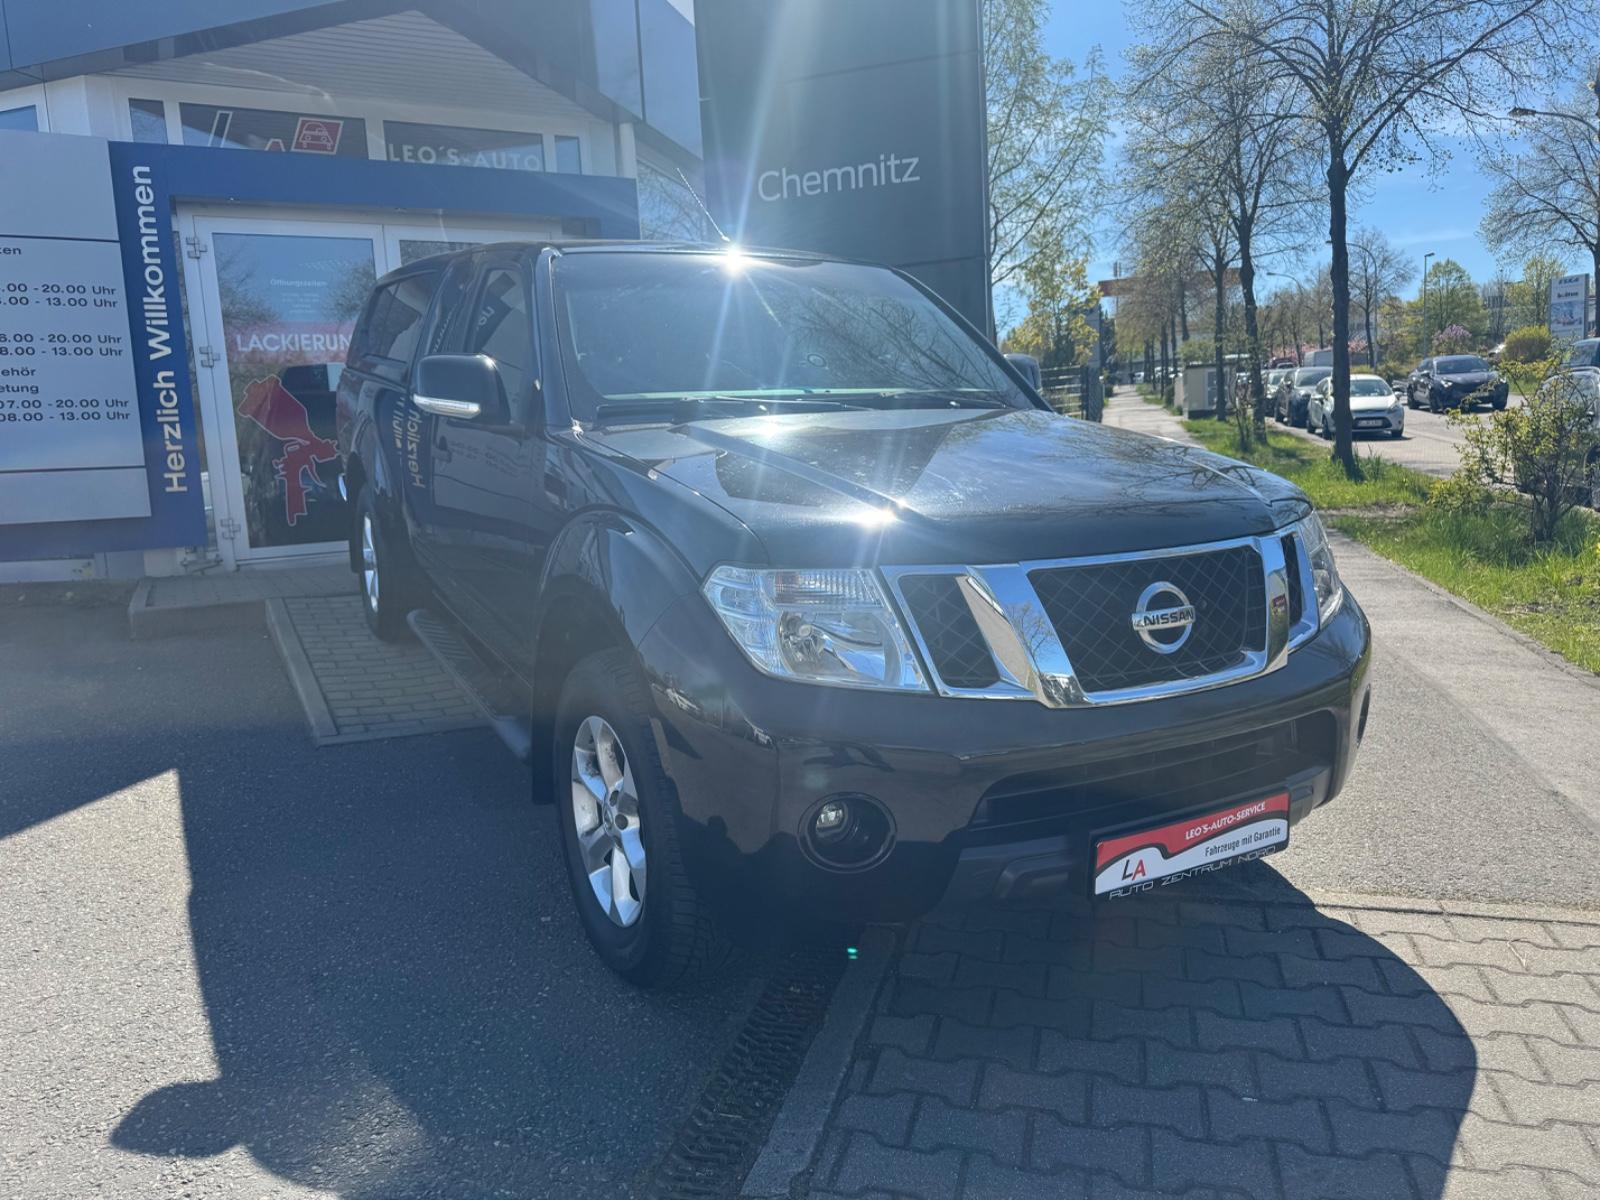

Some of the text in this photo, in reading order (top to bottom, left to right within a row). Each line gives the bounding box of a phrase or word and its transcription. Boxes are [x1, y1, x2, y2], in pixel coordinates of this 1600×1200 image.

[757, 153, 921, 201] Chemnitz
[0, 283, 28, 293] .00
[42, 284, 86, 294] 20.00
[92, 286, 117, 295] Uhr
[0, 296, 29, 306] .00
[46, 297, 88, 307] 13.00
[94, 299, 118, 308] Uhr
[132, 165, 188, 492] Herzlich Willkommen
[48, 334, 92, 344] 20.00
[98, 335, 122, 344] Uhr
[53, 347, 94, 357] 13.00
[99, 347, 124, 357] Uhr
[56, 399, 100, 409] 20.00
[105, 399, 129, 408] Uhr
[60, 411, 101, 421] 13.00
[106, 411, 131, 421] Uhr
[1143, 609, 1194, 627] NISSAN
[1205, 826, 1281, 857] Fahrzeuge mit Garantie
[1109, 845, 1276, 900] AUTO ZENTRUM NORD
[1121, 859, 1146, 881] LA
